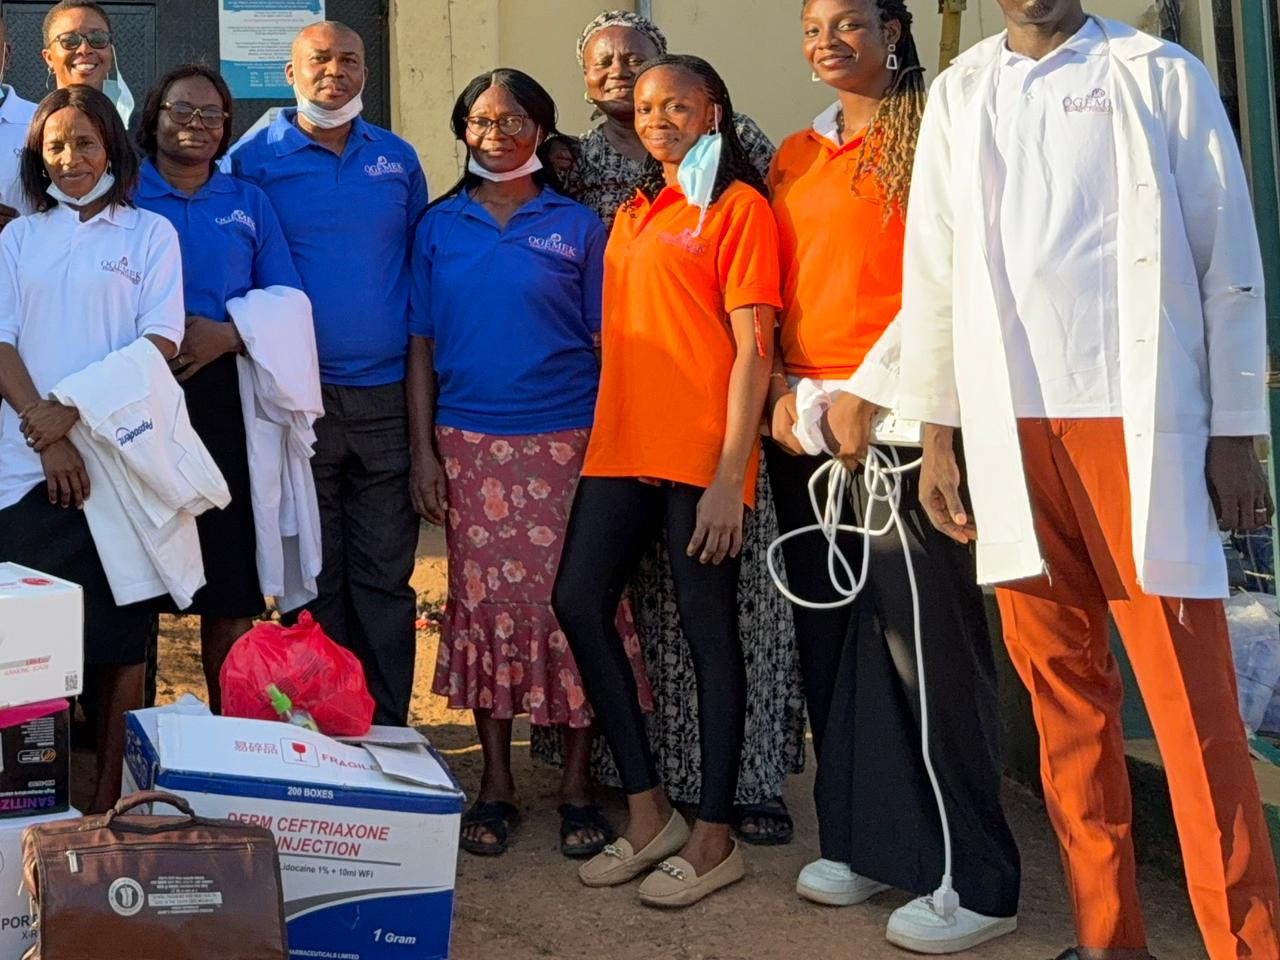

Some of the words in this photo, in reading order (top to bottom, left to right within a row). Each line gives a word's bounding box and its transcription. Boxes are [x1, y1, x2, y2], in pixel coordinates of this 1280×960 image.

[528, 235, 577, 255] OGEMEK
[287, 786, 302, 797] 200
[303, 787, 334, 800] BOXES
[277, 816, 390, 841] CEFTRIAXONE
[276, 835, 361, 857] INJECTION
[373, 928, 383, 942] 1
[385, 932, 417, 945] Gram
